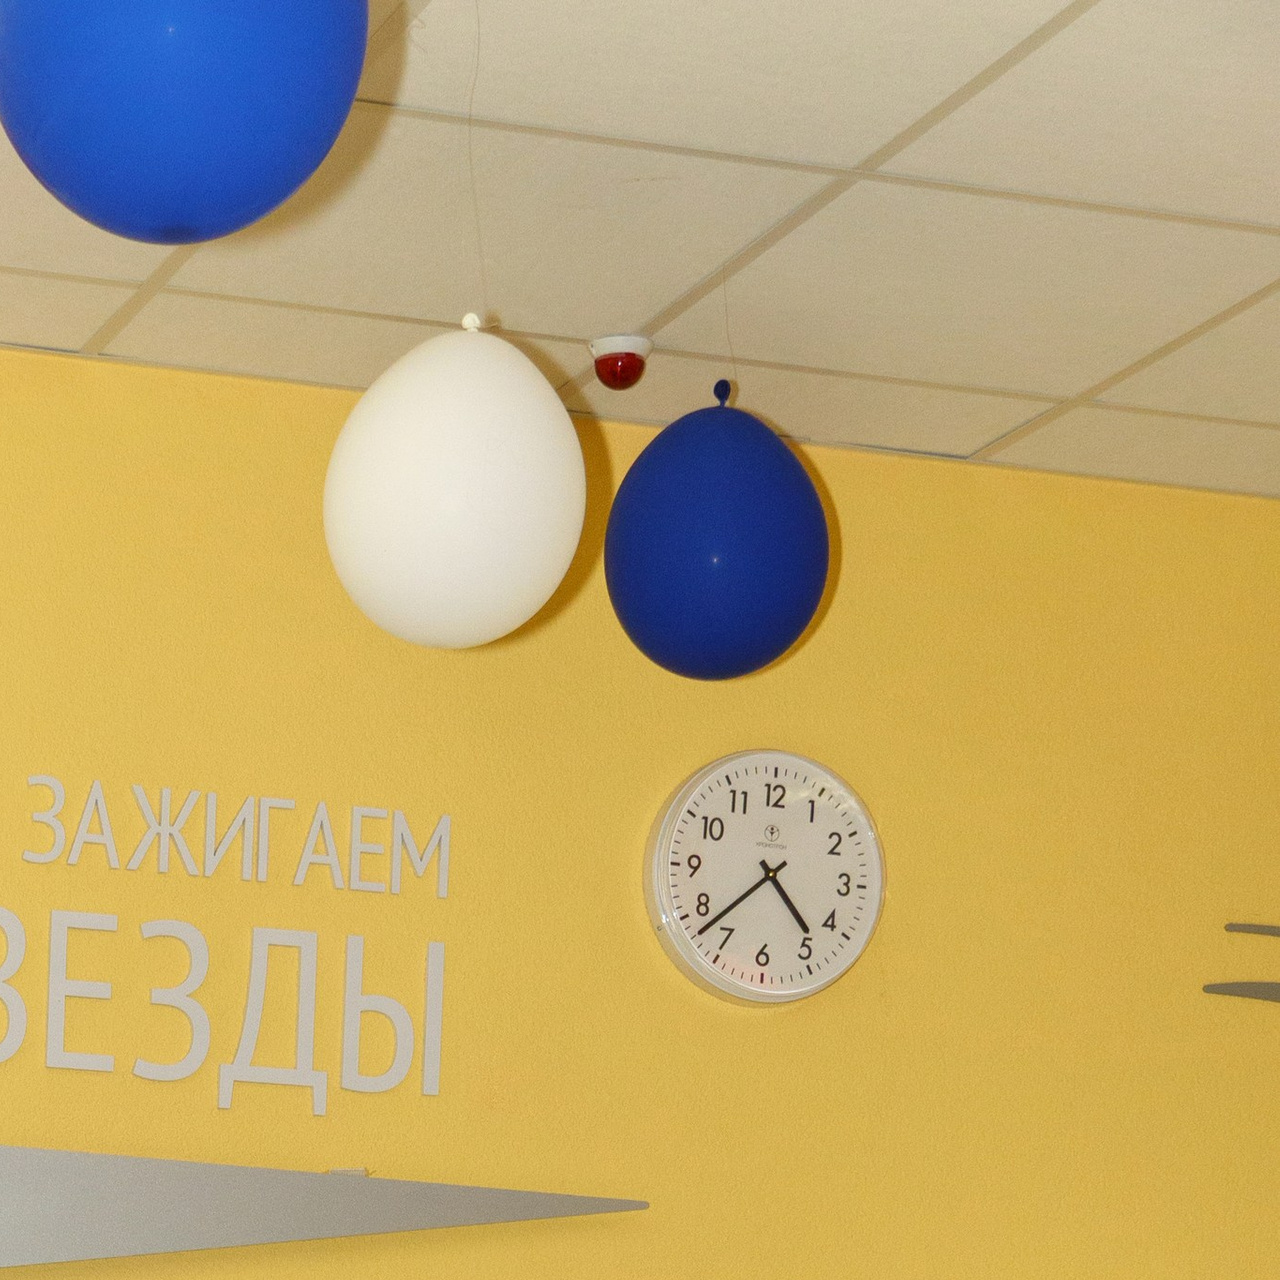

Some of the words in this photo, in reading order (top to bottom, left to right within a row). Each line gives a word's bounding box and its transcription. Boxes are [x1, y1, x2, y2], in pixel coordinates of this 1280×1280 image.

[730, 789, 748, 815] 11
[764, 783, 786, 809] 12
[808, 800, 815, 823] 1
[21, 774, 452, 899] ЗАЖИГАЕМ
[701, 816, 724, 841] 10
[827, 832, 842, 856] 2
[687, 854, 702, 878] 9
[836, 873, 851, 896] 3
[695, 893, 710, 917] 8
[822, 908, 836, 931] 4
[720, 927, 735, 950] 7
[797, 937, 813, 960] 5
[755, 944, 769, 967] 6
